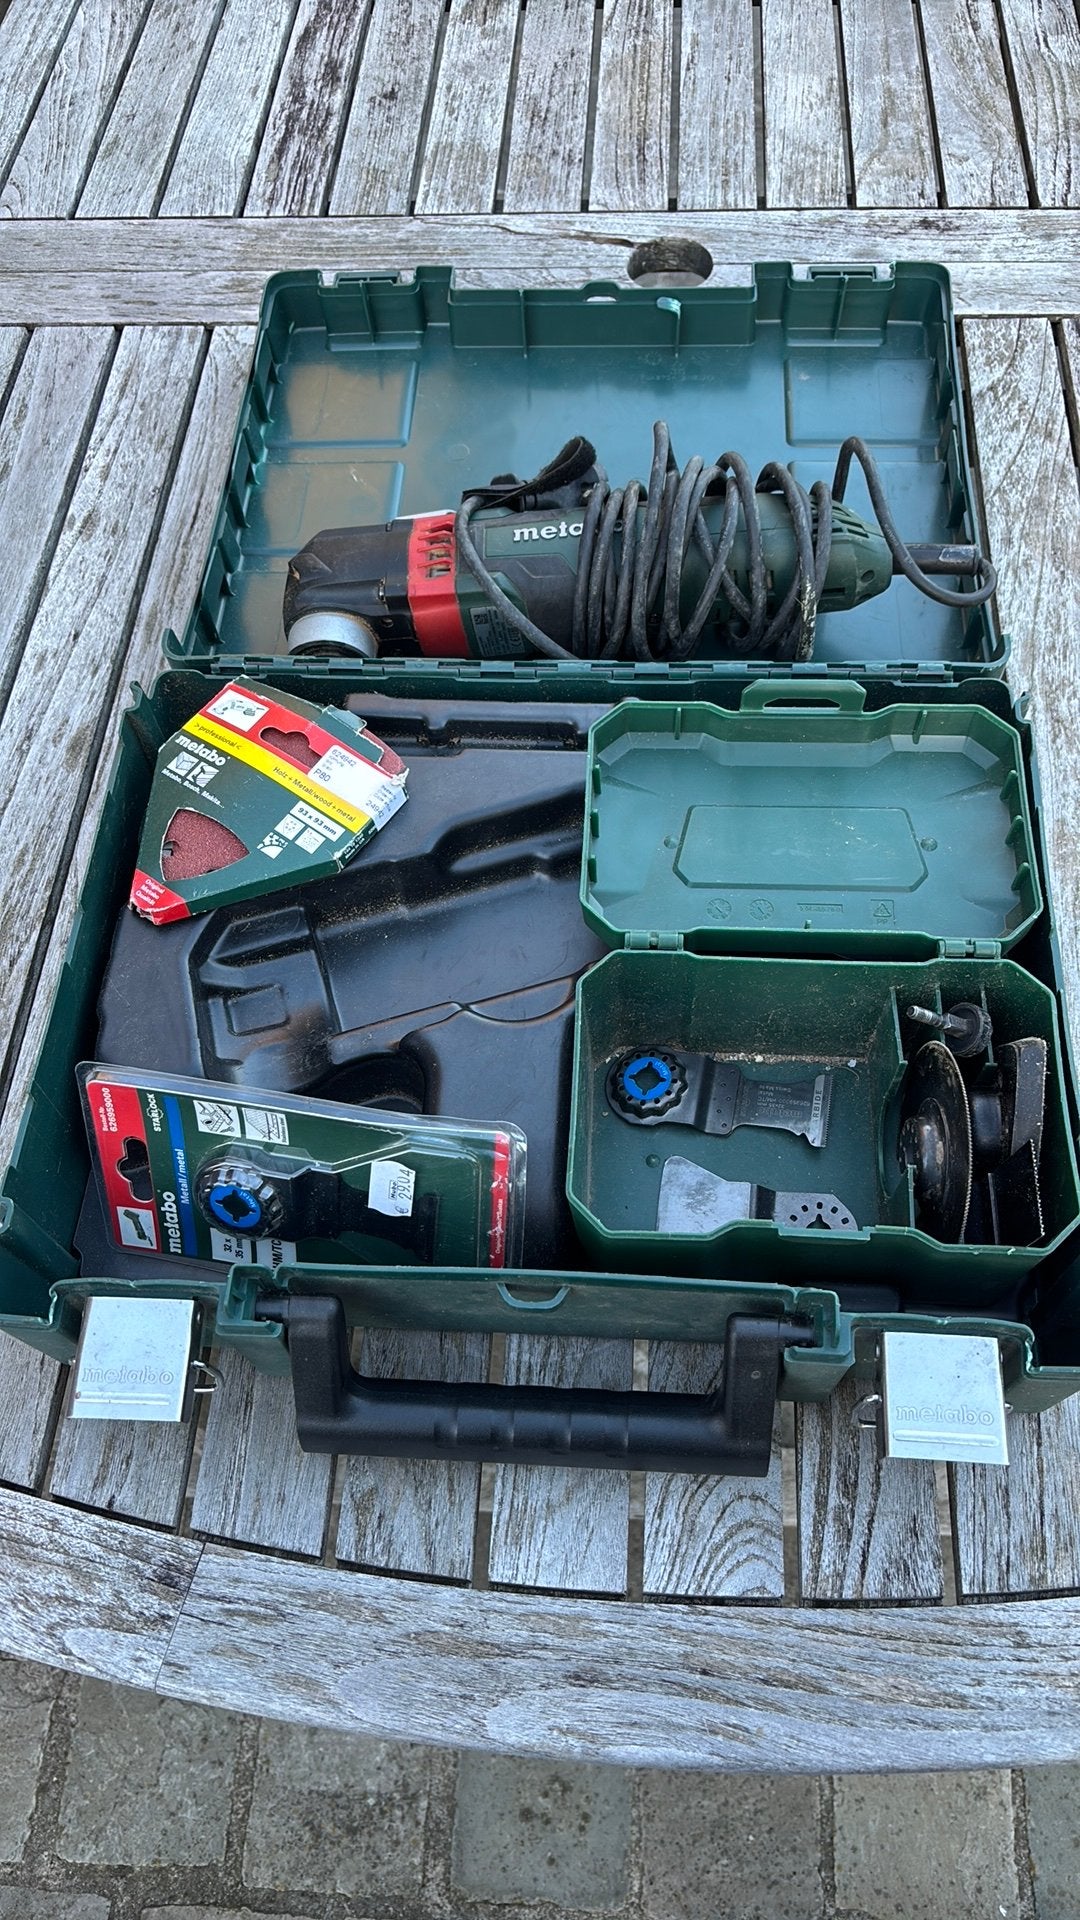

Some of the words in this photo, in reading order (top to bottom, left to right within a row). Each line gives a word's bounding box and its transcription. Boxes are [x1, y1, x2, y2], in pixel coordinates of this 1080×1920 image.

[513, 521, 583, 541] meta
[175, 735, 226, 766] metabo
[313, 768, 331, 782] P80
[273, 767, 288, 778] Holz
[336, 807, 356, 822] metal
[297, 807, 309, 816] 93
[313, 817, 324, 826] 93
[323, 825, 337, 835] mm
[102, 1087, 118, 1132] 626959000
[147, 1093, 162, 1132] STARLOCK
[813, 1090, 822, 1118] RBIDE
[397, 1169, 413, 1200] 29.04
[161, 1191, 182, 1254] metabo
[395, 1206, 409, 1214] €
[223, 1243, 232, 1252] 32
[235, 1249, 243, 1259] 35
[82, 1365, 174, 1385] metabo
[896, 1404, 994, 1427] metabo
